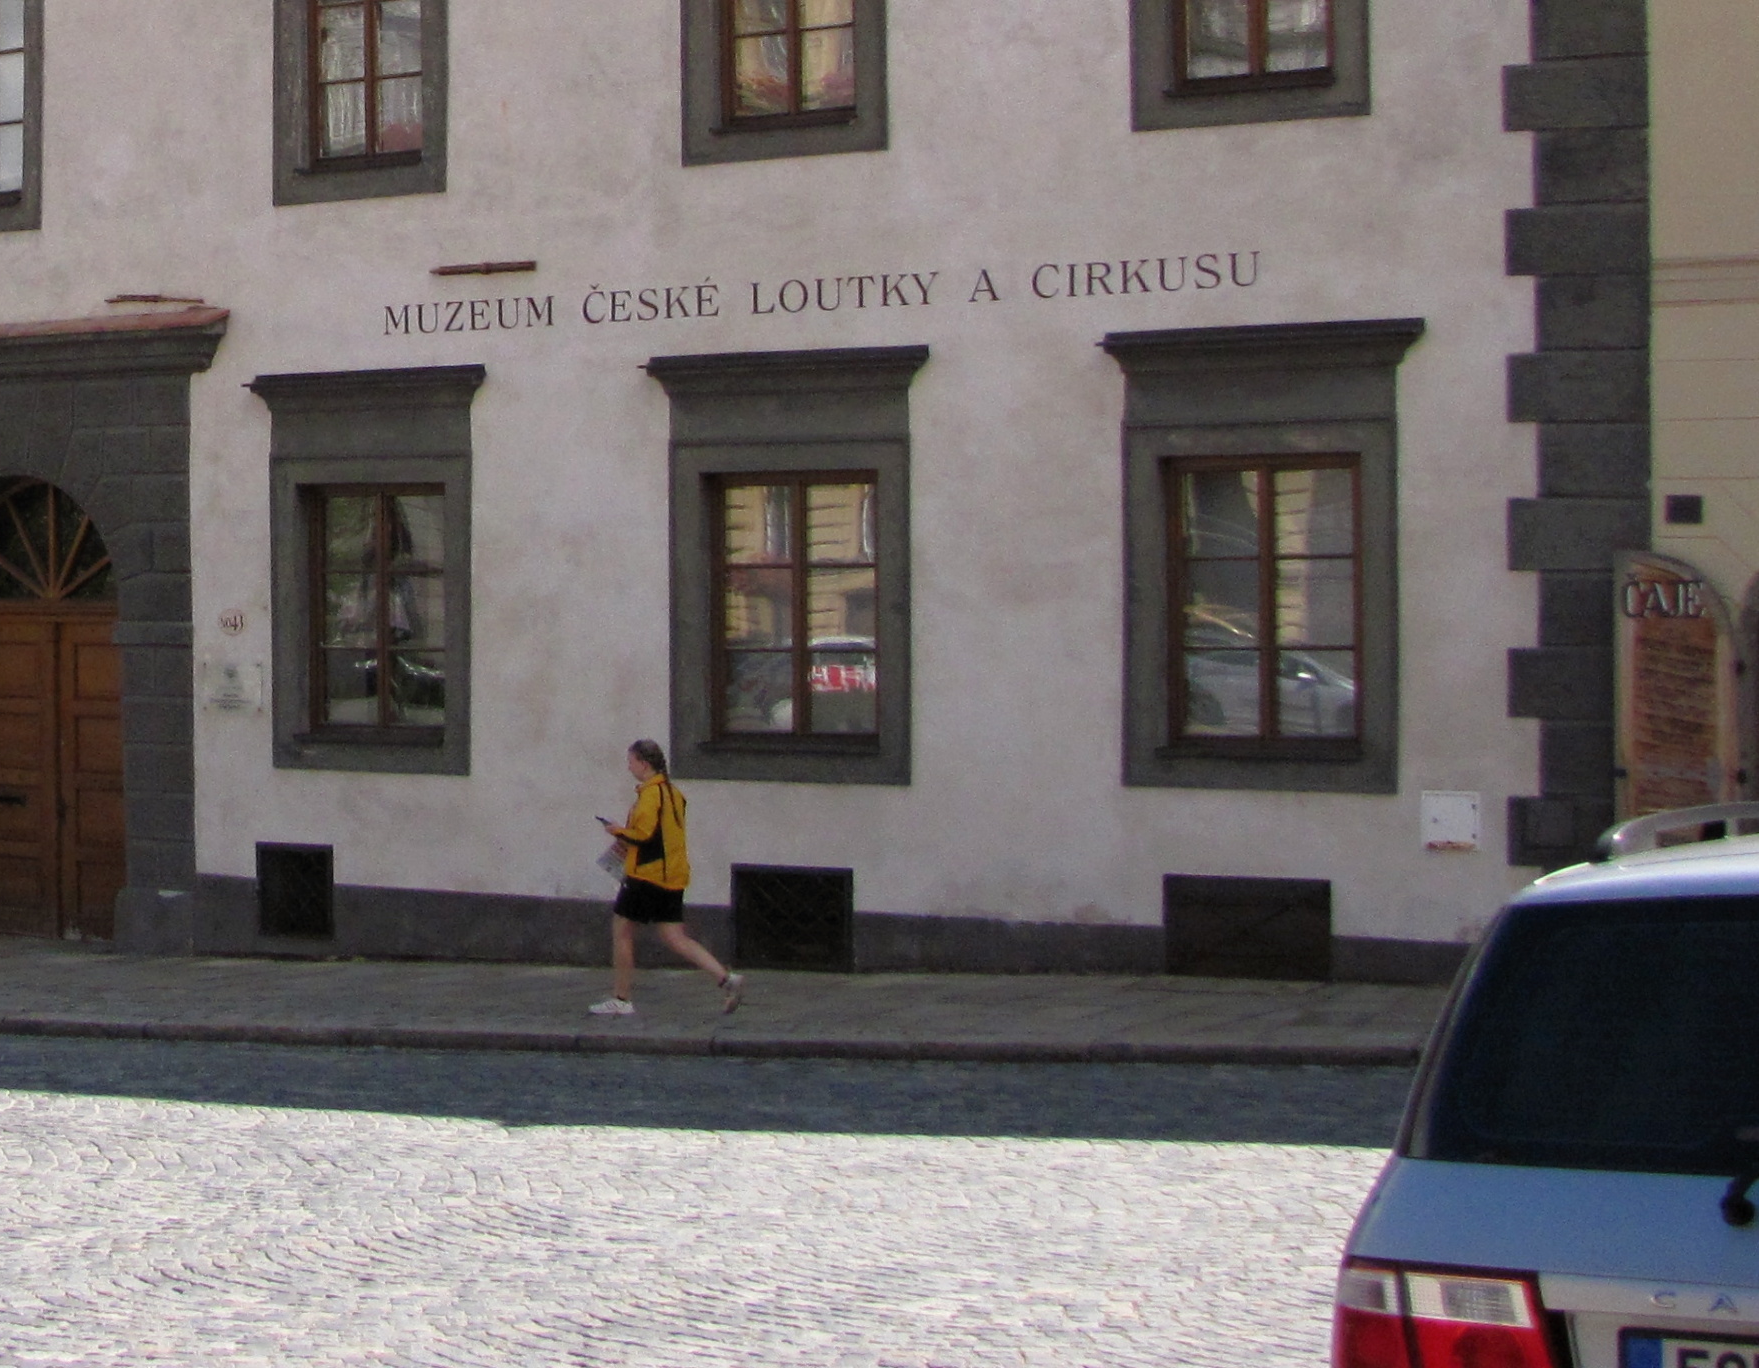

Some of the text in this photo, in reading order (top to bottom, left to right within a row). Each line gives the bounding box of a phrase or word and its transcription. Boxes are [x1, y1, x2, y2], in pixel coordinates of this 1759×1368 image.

[383, 250, 1260, 335] MUZEUM ČESKÉ LOUTKY A CIRKUSU
